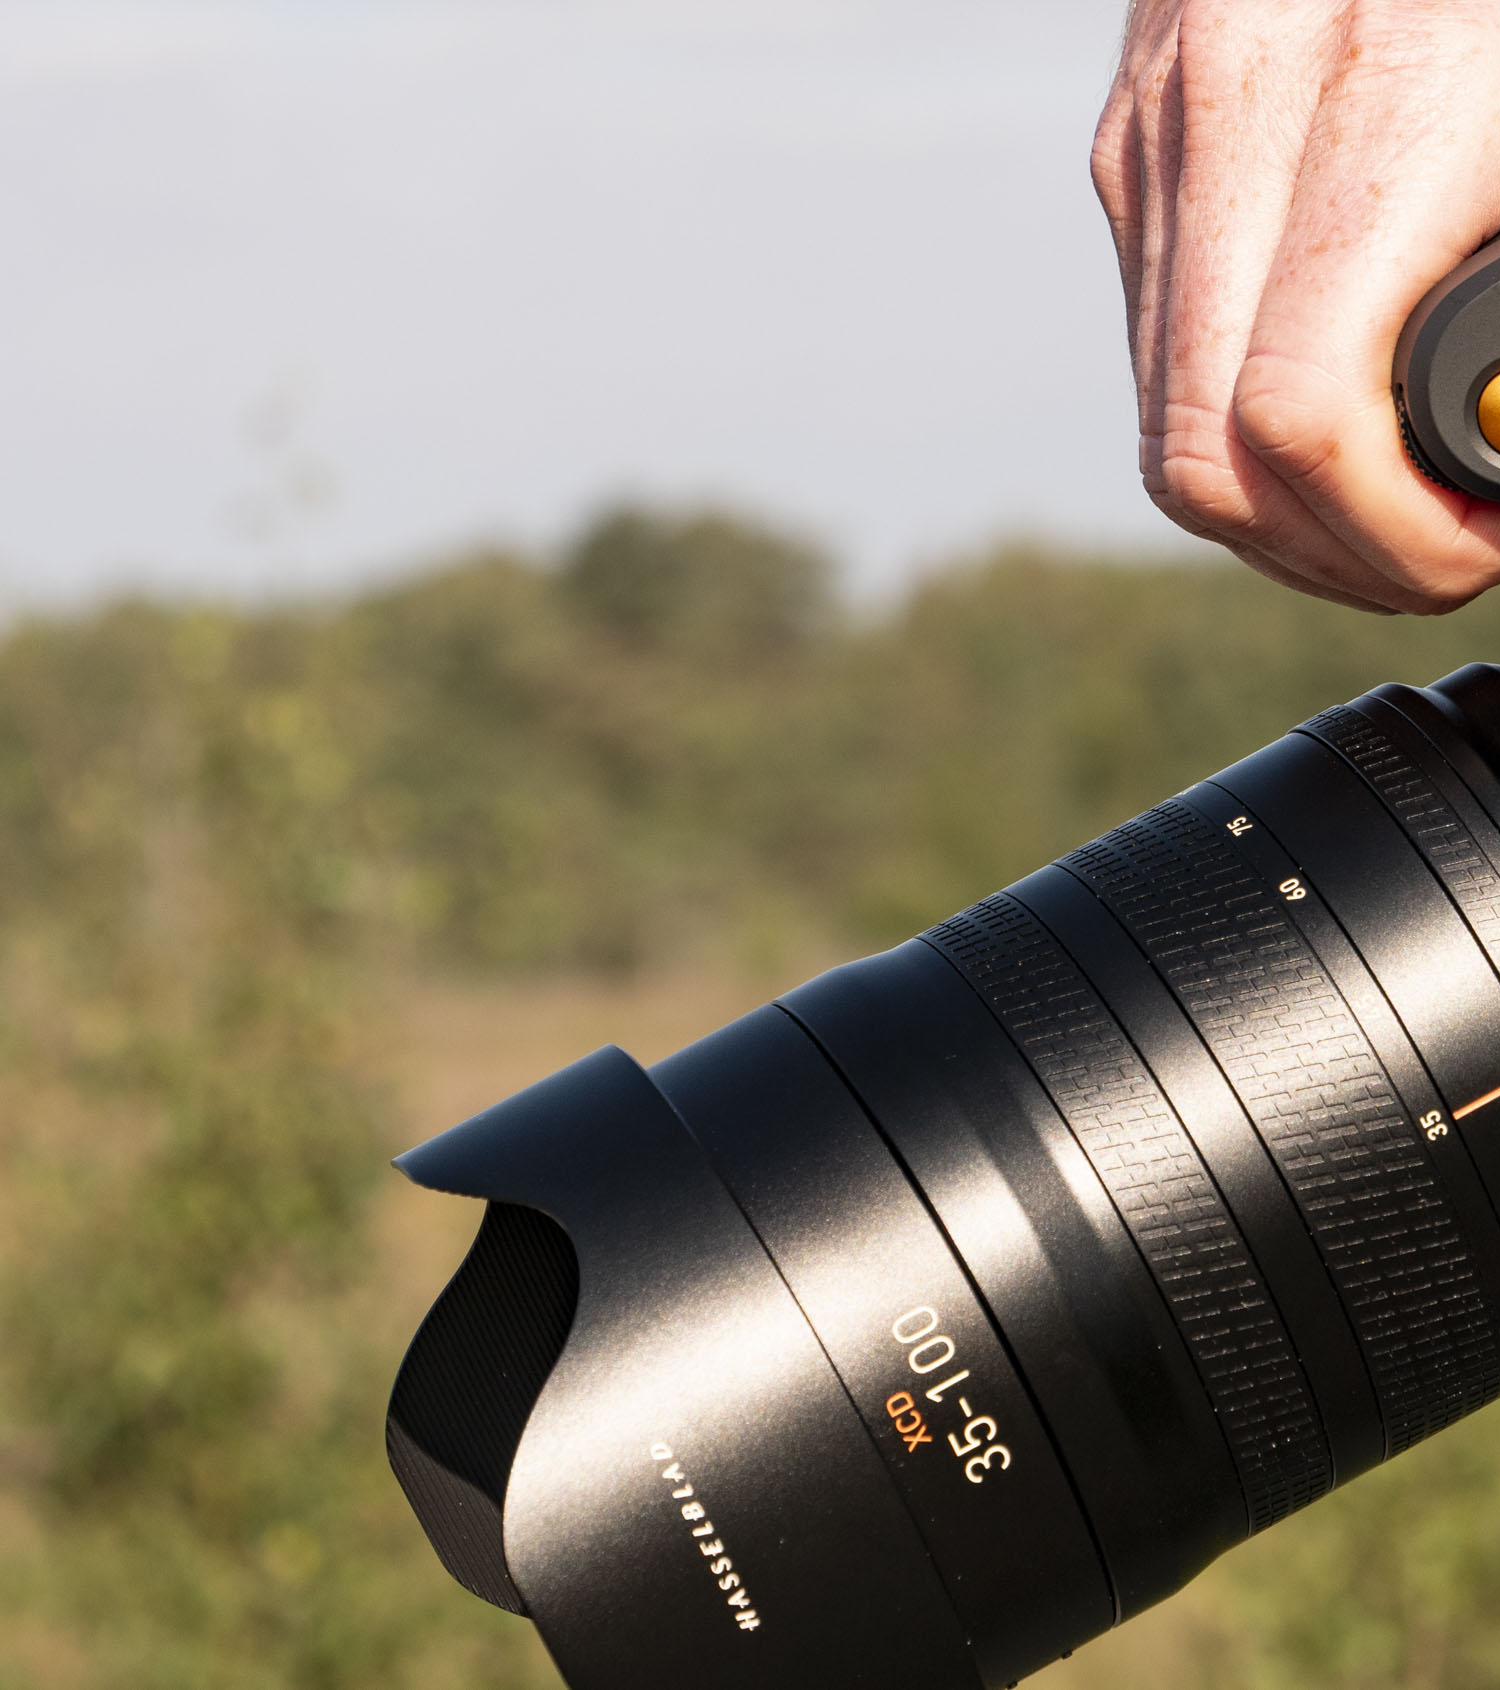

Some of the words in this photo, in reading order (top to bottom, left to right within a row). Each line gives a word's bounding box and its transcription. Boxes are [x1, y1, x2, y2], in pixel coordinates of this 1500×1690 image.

[1226, 816, 1253, 837] 75
[1279, 878, 1306, 901] 60
[1419, 1110, 1448, 1141] 35
[892, 1306, 1011, 1484] 35-100
[886, 1391, 933, 1452] XCD
[650, 1441, 760, 1631] HASSELBLAD
